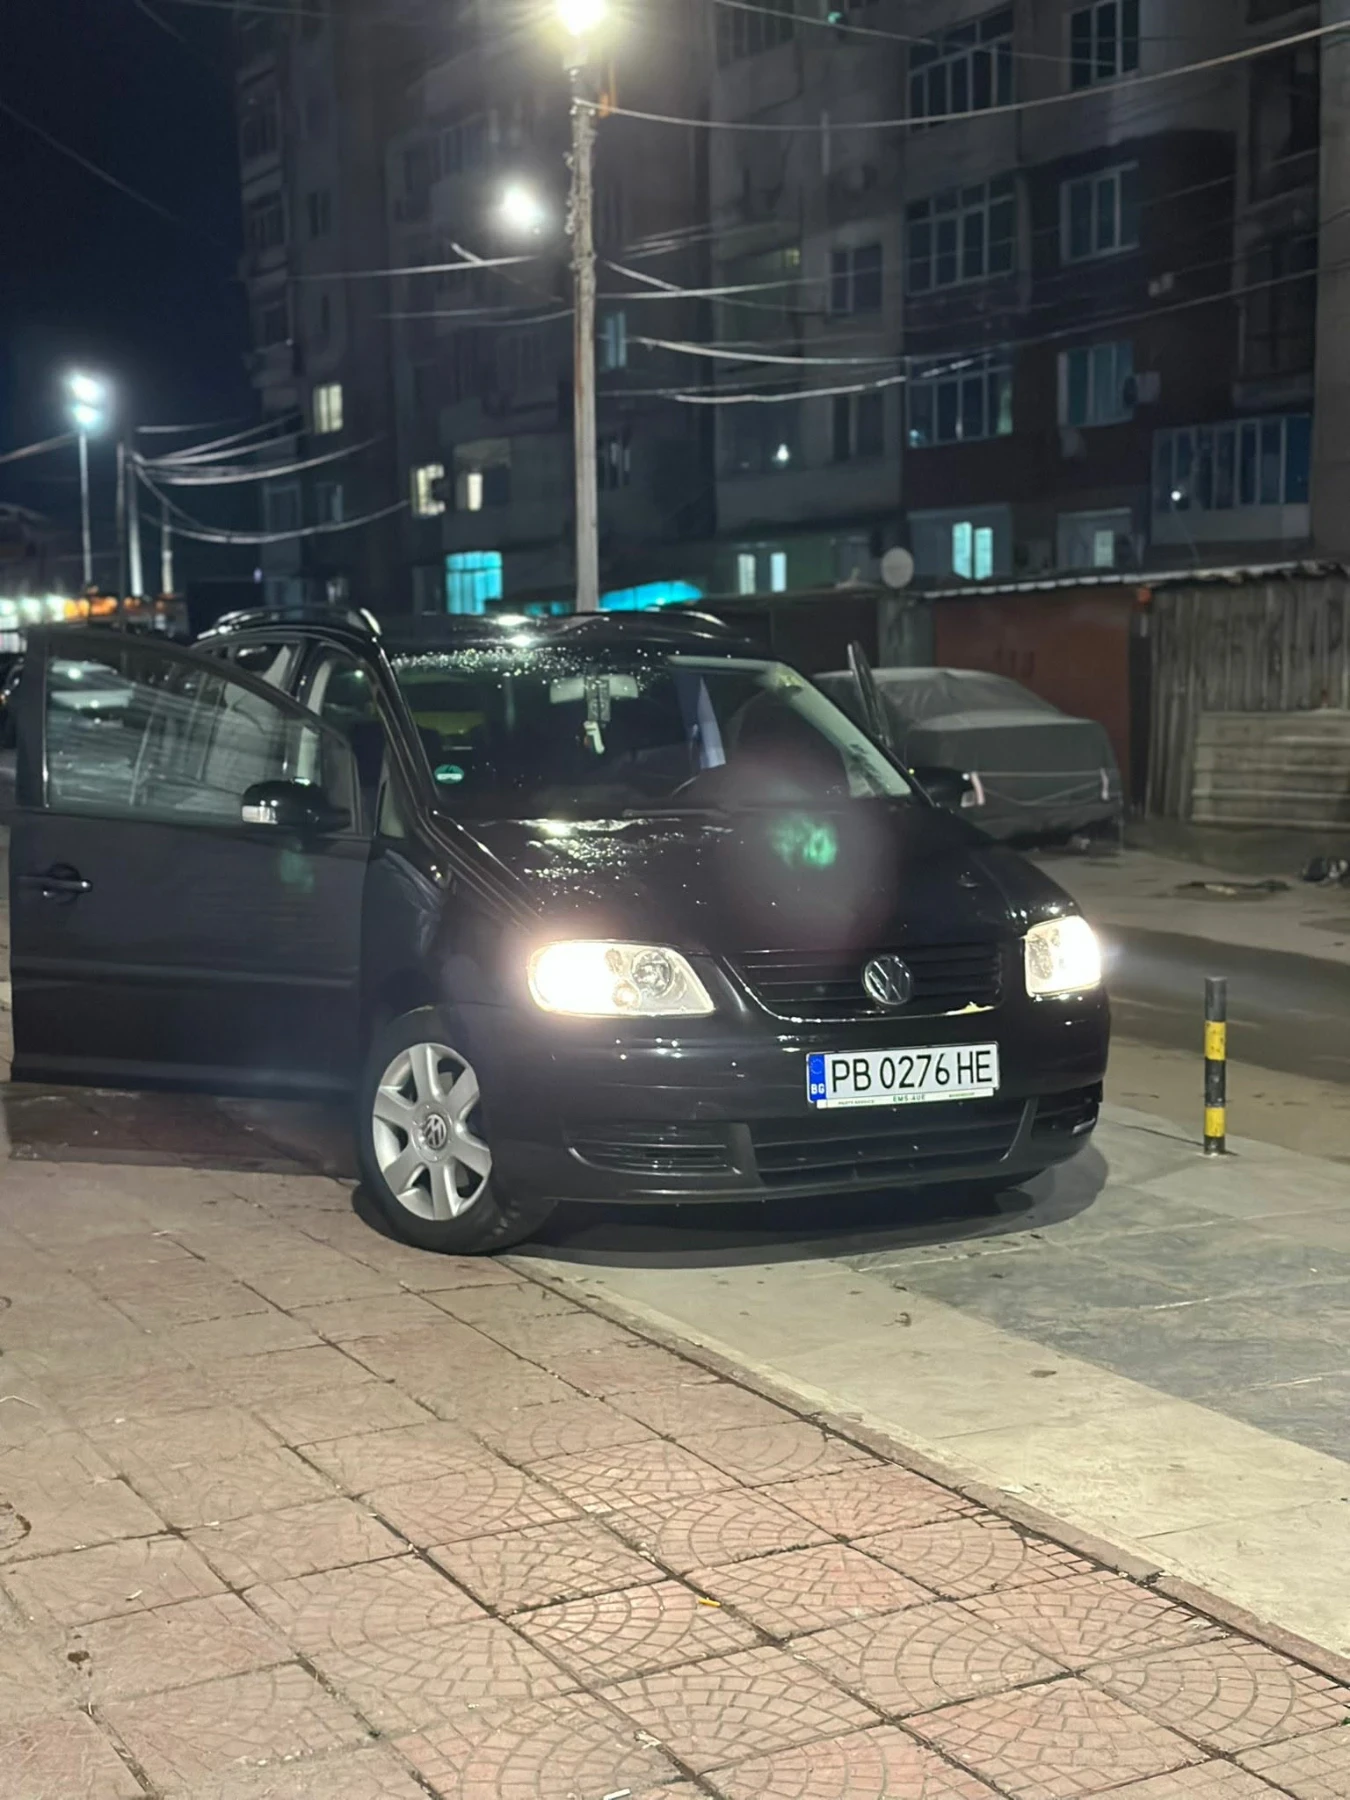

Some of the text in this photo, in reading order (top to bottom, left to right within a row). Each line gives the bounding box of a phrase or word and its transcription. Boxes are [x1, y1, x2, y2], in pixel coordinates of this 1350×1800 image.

[831, 1050, 992, 1092] PB 0276 HE
[811, 1083, 825, 1094] BG
